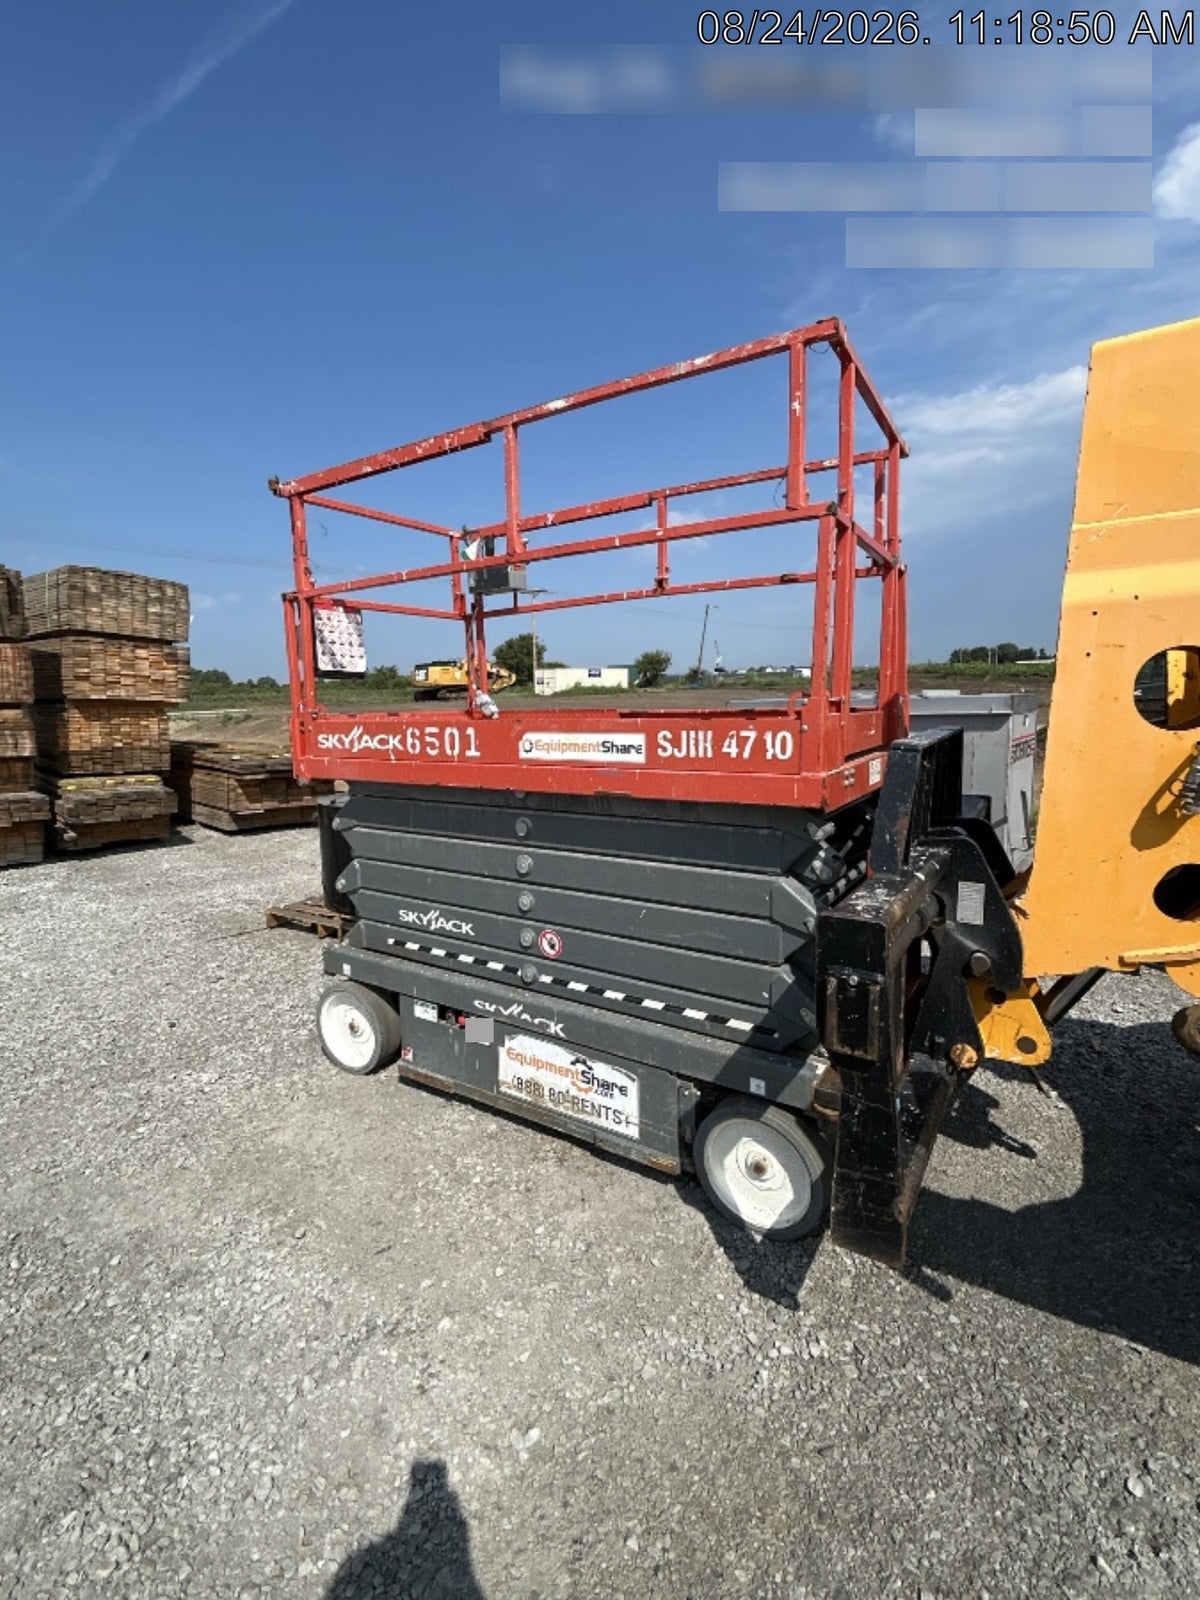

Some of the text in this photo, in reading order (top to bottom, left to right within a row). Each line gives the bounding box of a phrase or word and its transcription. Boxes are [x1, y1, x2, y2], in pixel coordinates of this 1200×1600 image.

[317, 725, 404, 753] SKYJACK
[406, 726, 481, 757] 6501
[534, 740, 643, 755] EquipmentShare
[398, 909, 476, 936] SKYJACK
[506, 1047, 629, 1097] EquipmentShare
